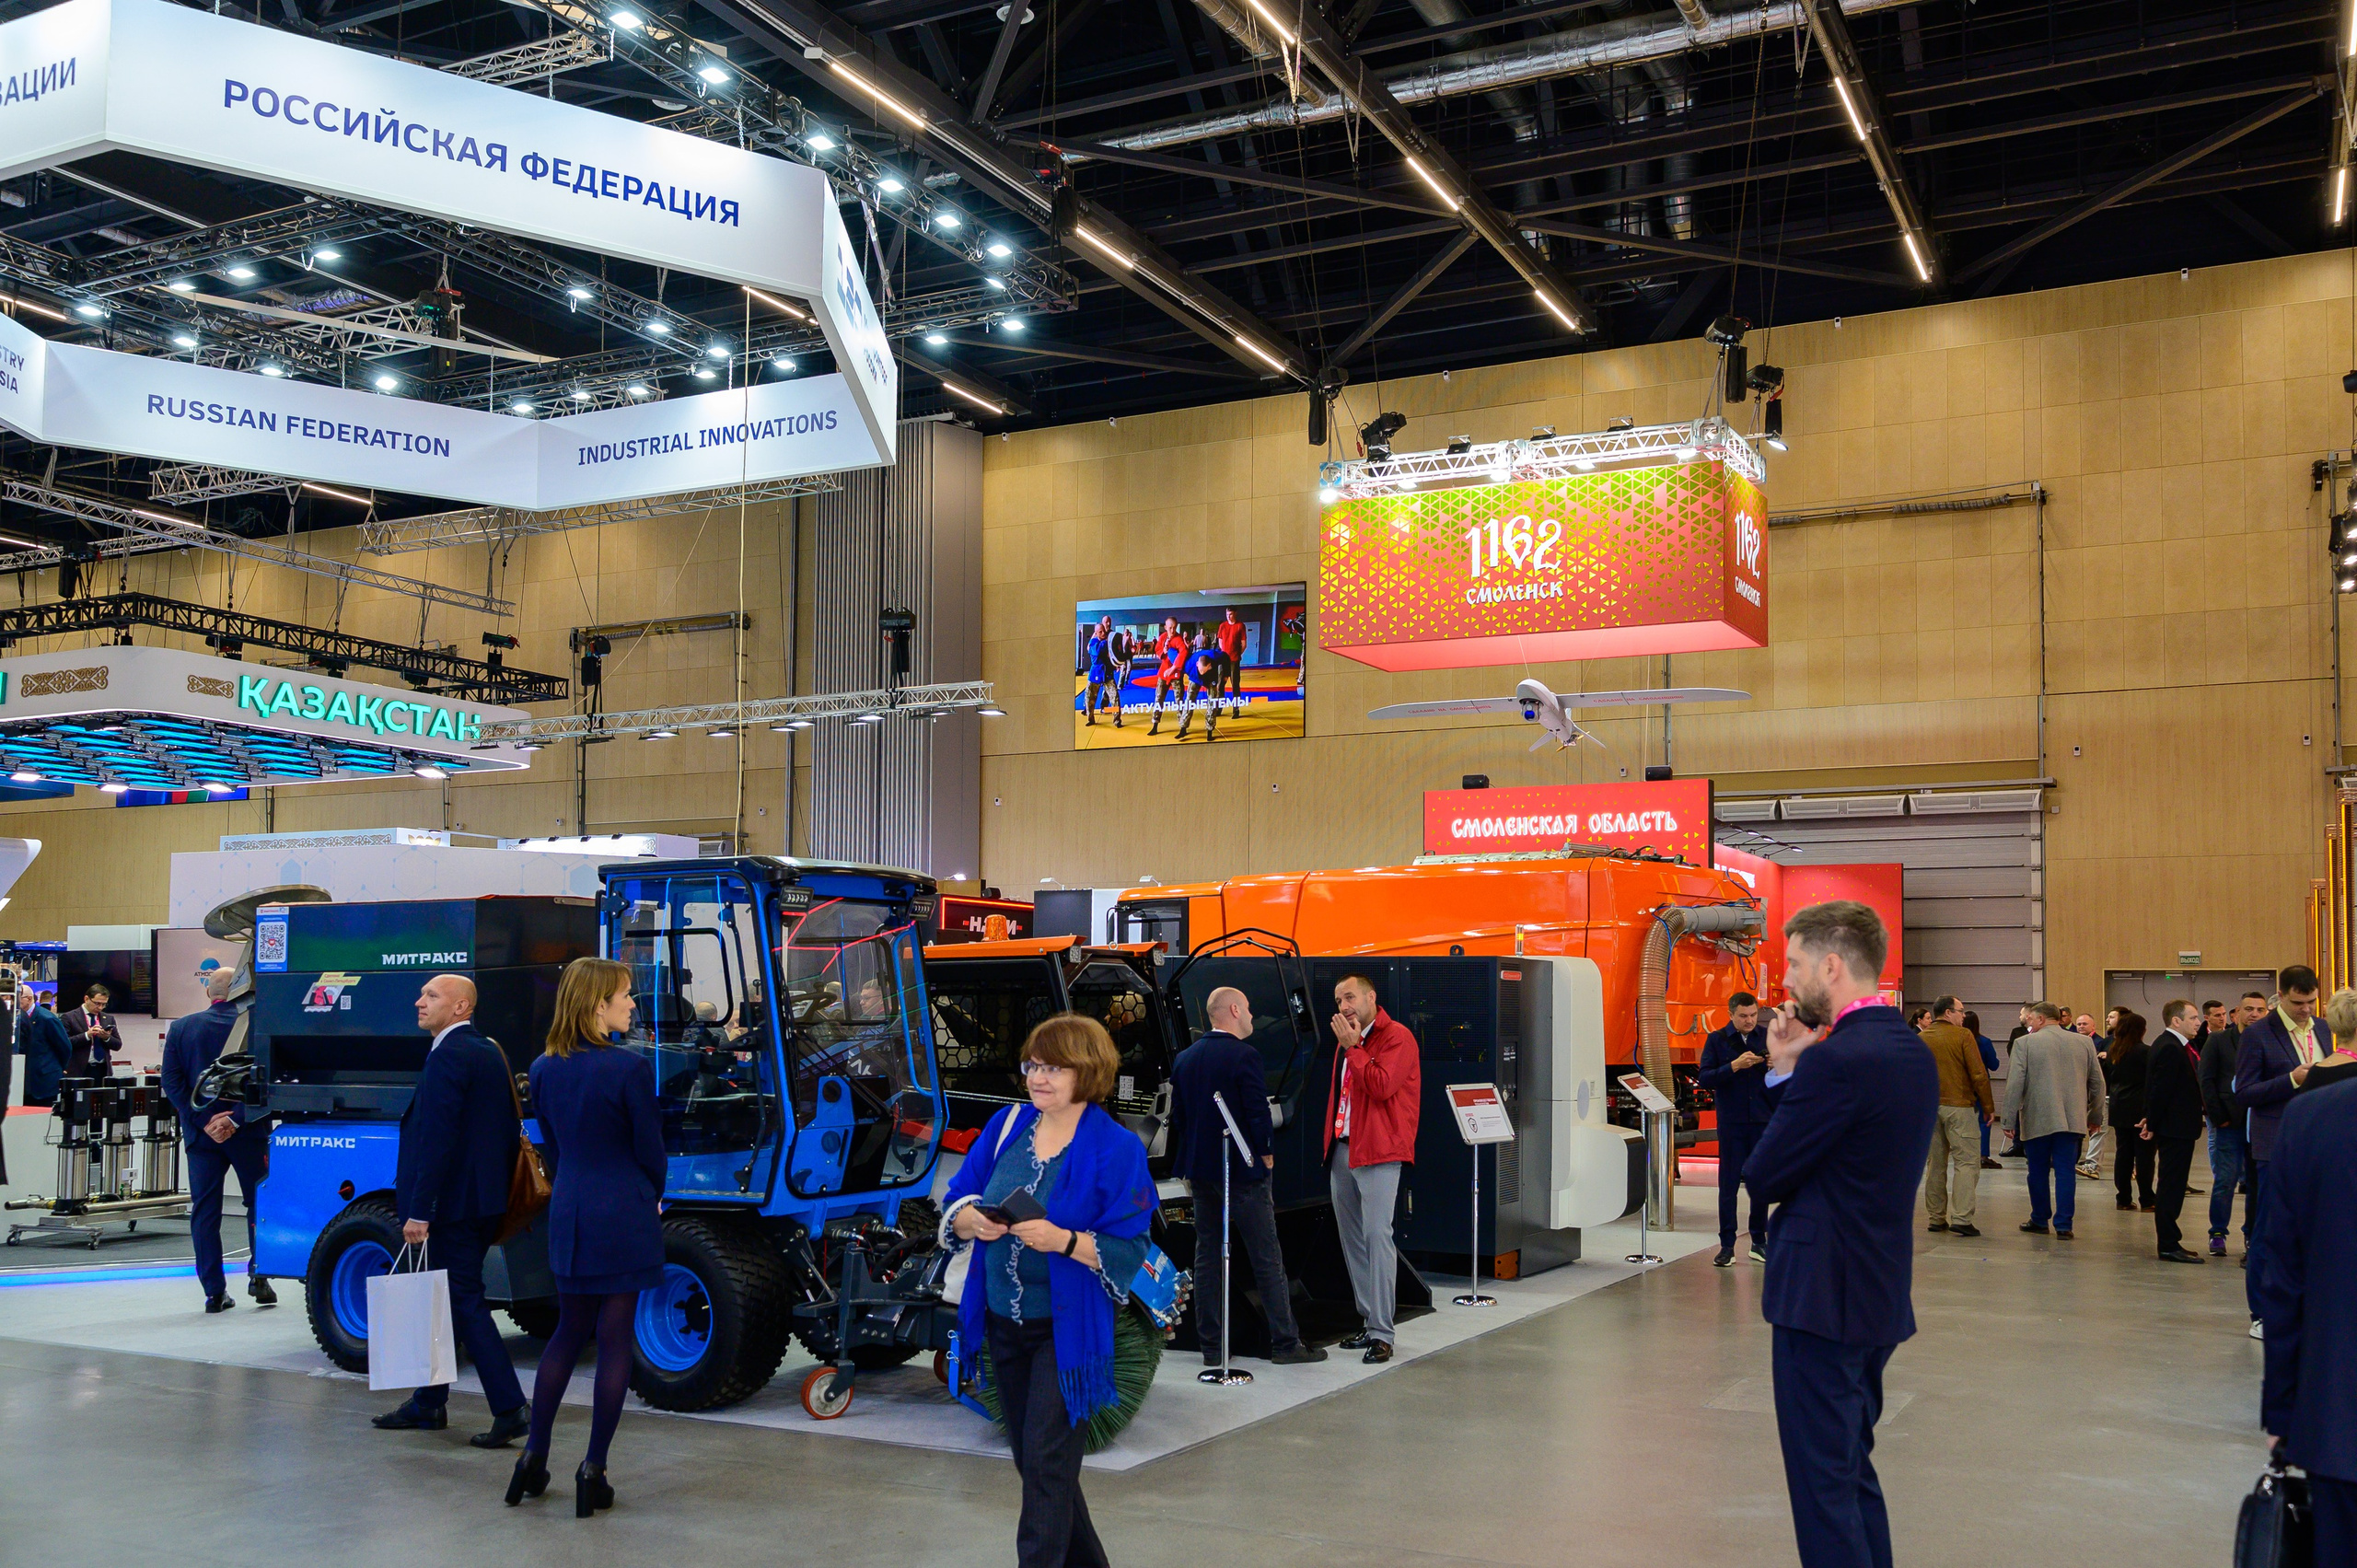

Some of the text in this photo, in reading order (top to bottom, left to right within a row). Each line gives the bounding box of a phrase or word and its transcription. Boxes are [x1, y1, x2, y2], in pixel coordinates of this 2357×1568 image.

[0, 57, 75, 106] АЦИИ
[224, 79, 739, 227] РОССИЙСКАЯ ФЕДЕРАЦИЯ
[0, 345, 24, 371] TRY
[147, 393, 450, 458] RUSSIAN FEDERATION
[578, 410, 838, 466] INDUSTRIAL INNOVATIONS
[1465, 514, 1562, 578] 1162
[1735, 509, 1760, 580] 1162
[1466, 581, 1563, 605] СМОЛЕНСК
[238, 675, 481, 741] ҚАЗАҚСТАН
[1121, 696, 1248, 714] АКТУАЛЬНЫЕ ТЕМЫ
[1451, 811, 1678, 839] СМОЛЕНСКАЯ ОБЛАСТЬ
[381, 952, 467, 965] МИТРАКС
[275, 1136, 355, 1148] МИТРАКС
